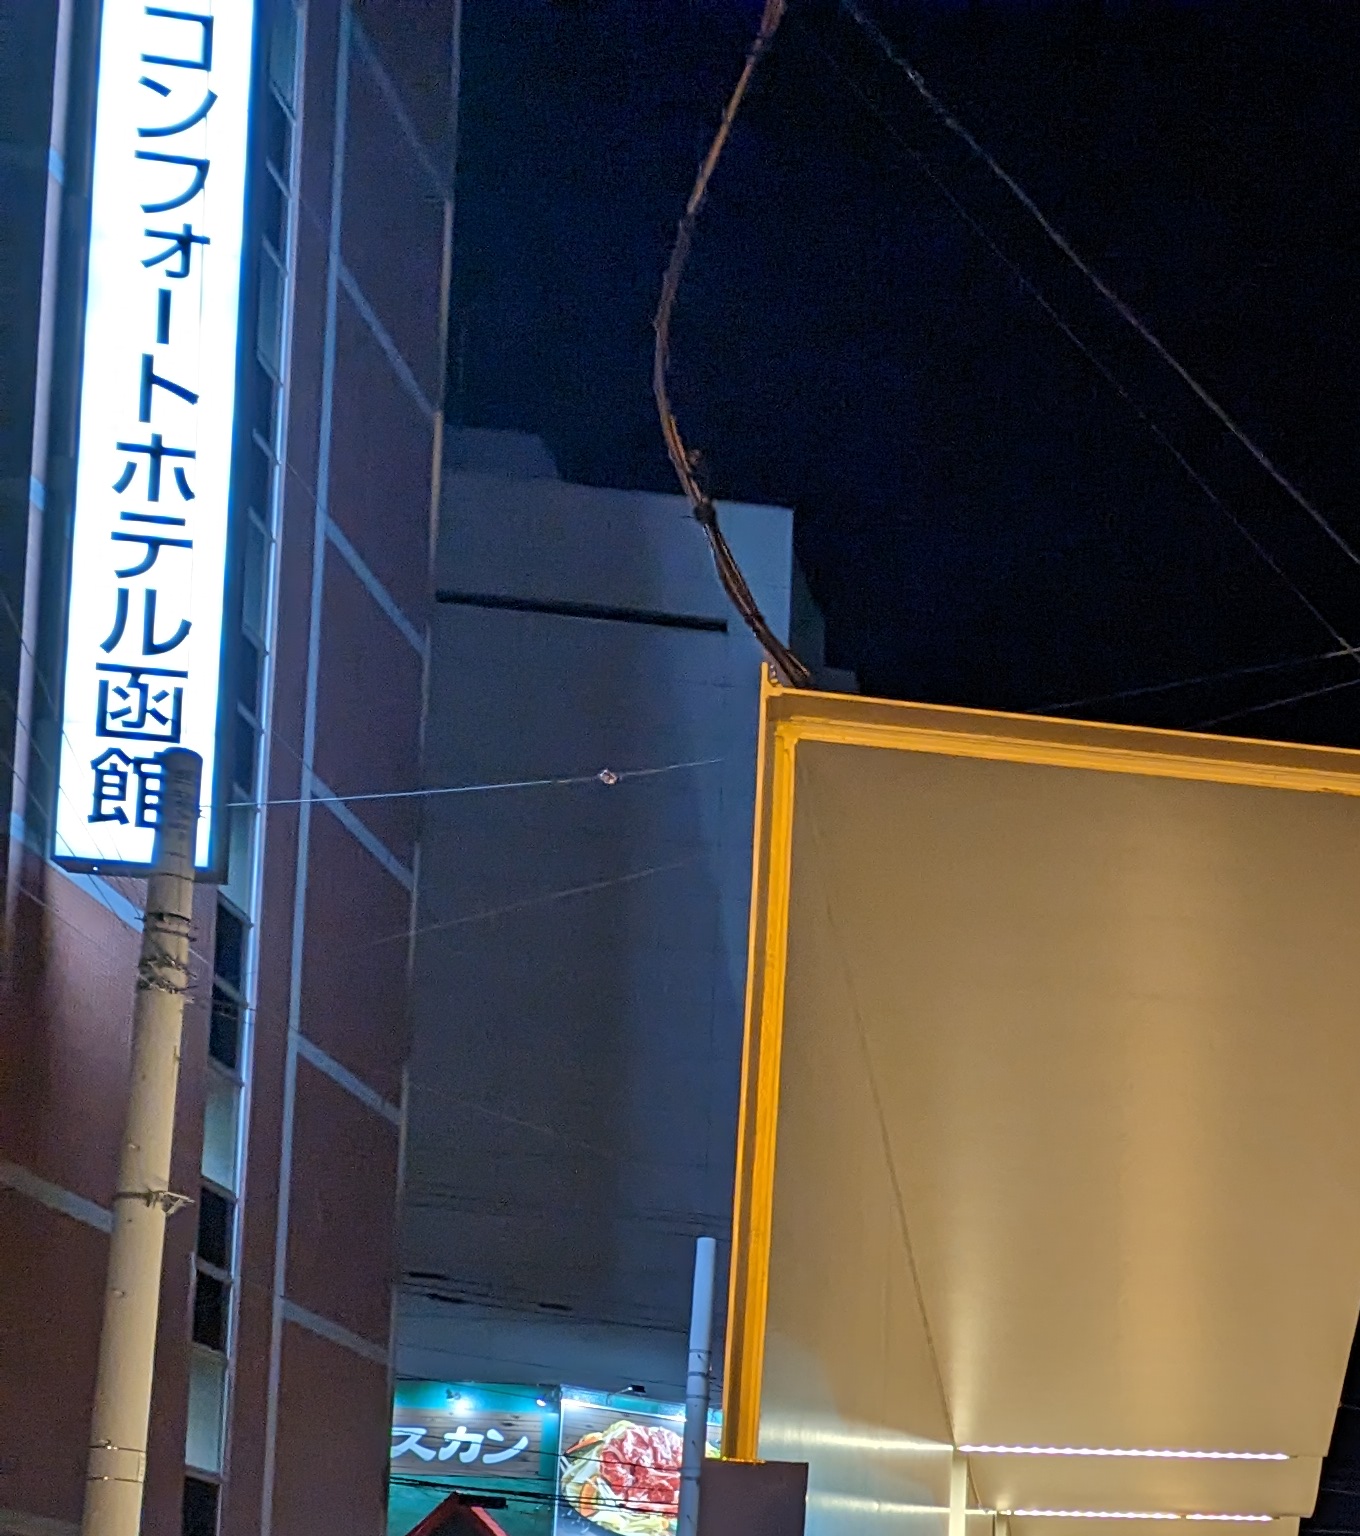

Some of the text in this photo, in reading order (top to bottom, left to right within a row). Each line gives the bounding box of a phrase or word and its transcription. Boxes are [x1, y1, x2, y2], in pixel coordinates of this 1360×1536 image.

[88, 5, 216, 830] コンフォートホテル函館
[391, 1426, 528, 1464] スカン
